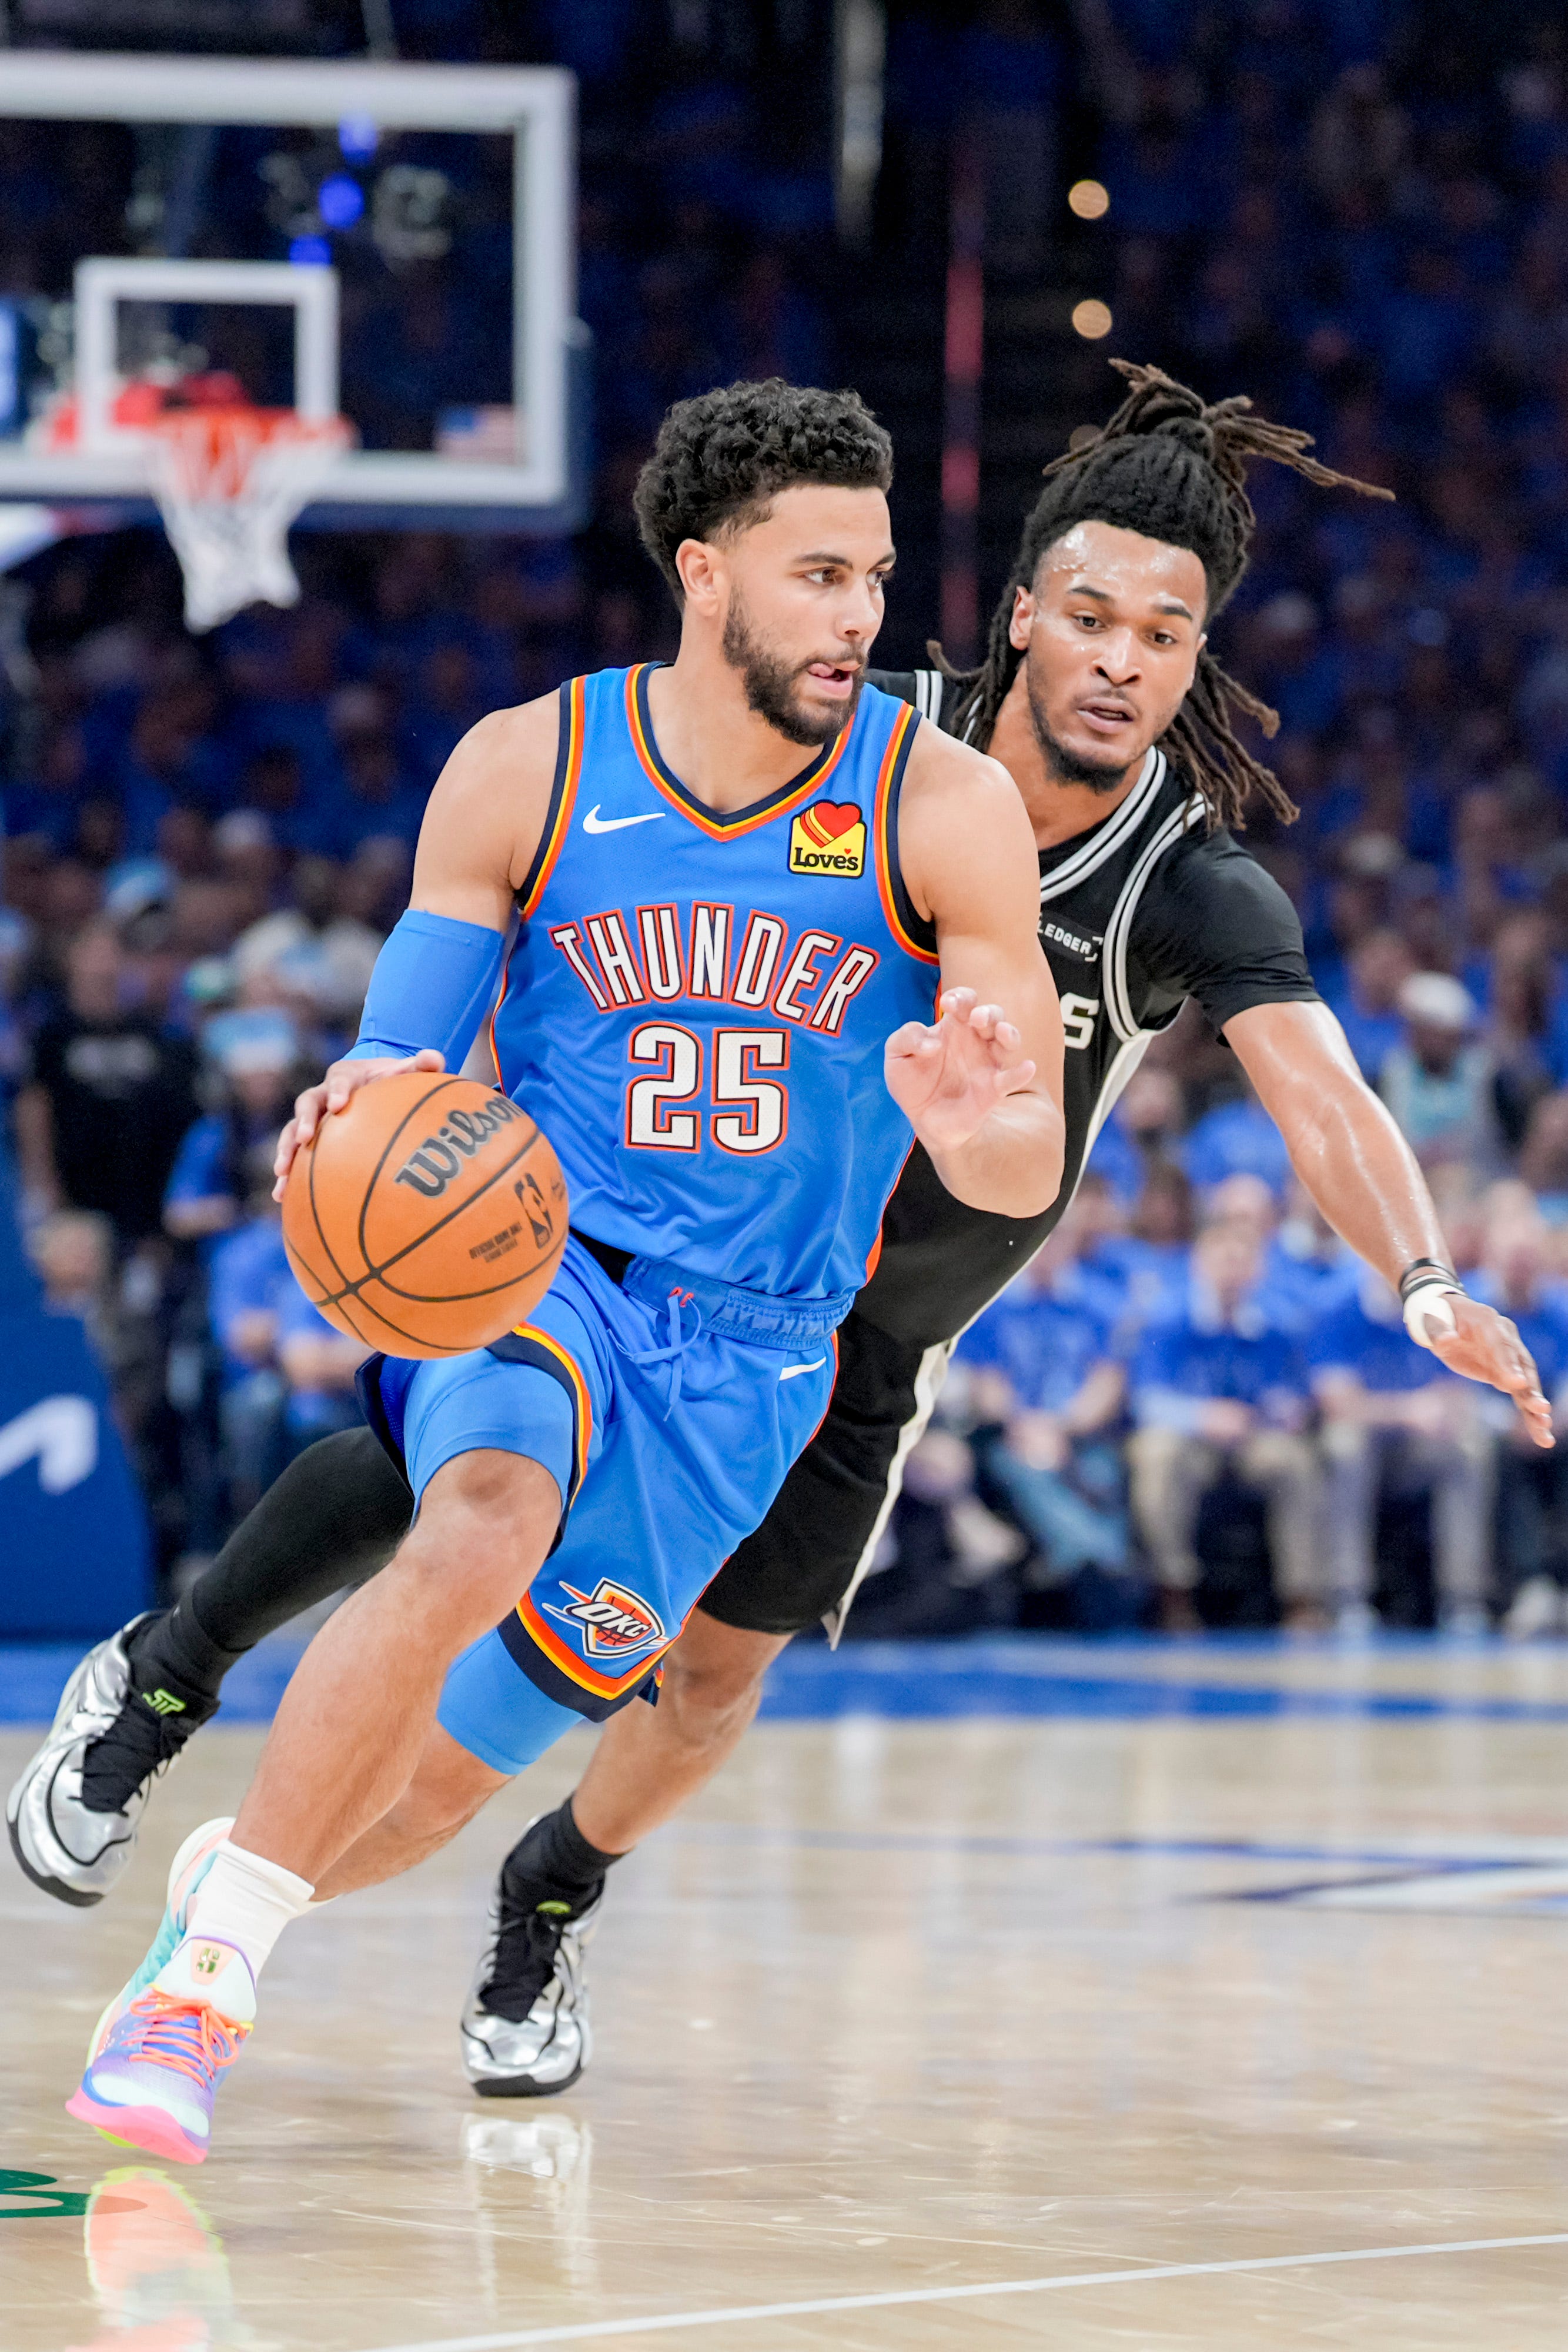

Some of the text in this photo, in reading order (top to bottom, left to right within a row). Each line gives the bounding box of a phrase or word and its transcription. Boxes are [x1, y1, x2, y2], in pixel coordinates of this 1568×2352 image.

[549, 900, 880, 1037] THUNDER
[1037, 921, 1092, 955] LEDGER
[624, 1021, 790, 1157] 25
[393, 1095, 526, 1197] Wilson
[569, 1601, 651, 1638] OKC
